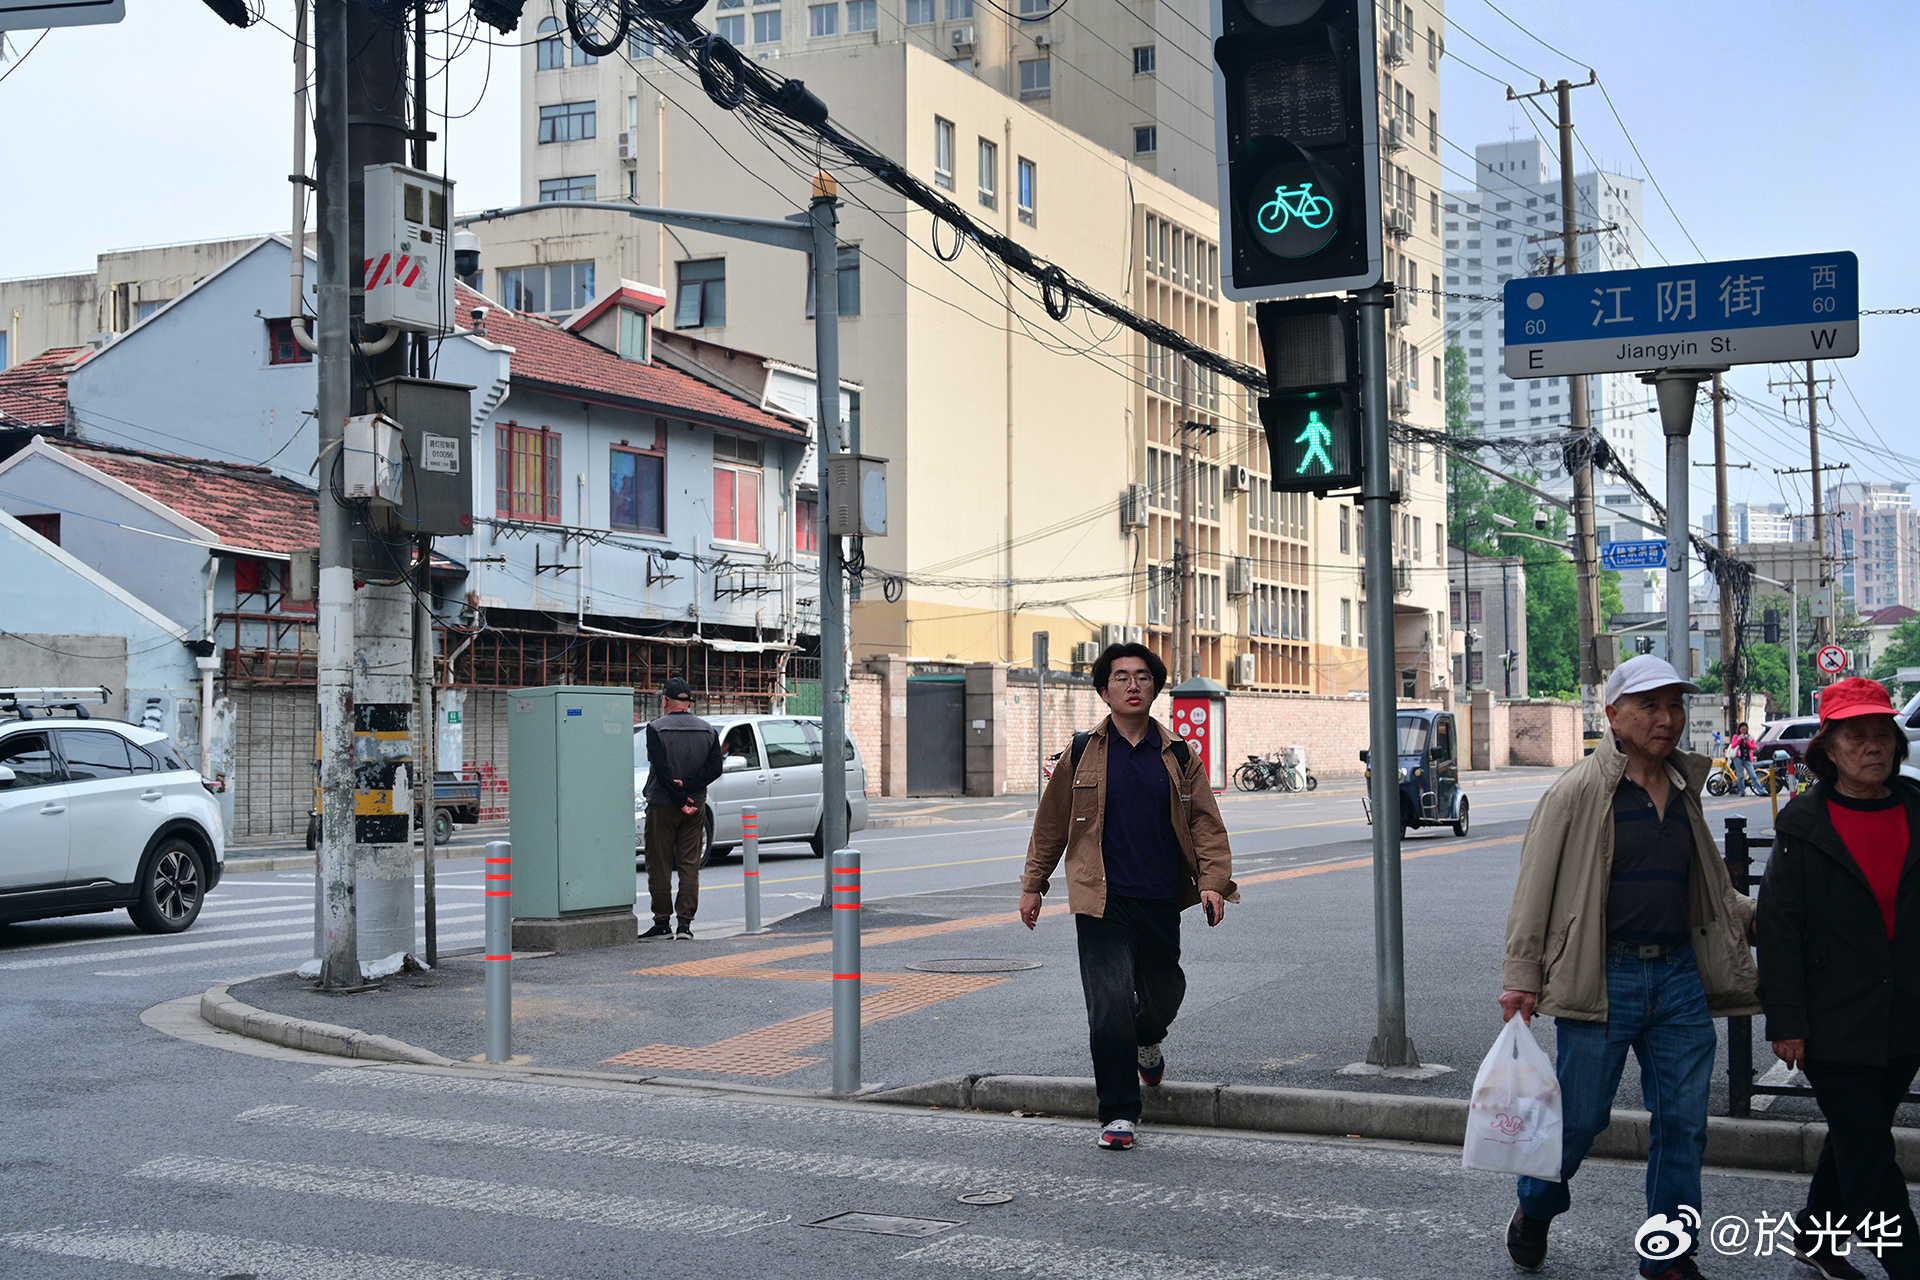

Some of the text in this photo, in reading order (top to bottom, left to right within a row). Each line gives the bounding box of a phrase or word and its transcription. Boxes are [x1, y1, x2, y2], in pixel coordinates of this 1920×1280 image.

[1810, 264, 1838, 290] 西
[1591, 274, 1766, 327] 江阴街
[1813, 296, 1836, 313] 60
[1525, 319, 1546, 335] 60
[1616, 336, 1737, 361] Jiangyin St.
[1810, 328, 1837, 350] W
[1529, 349, 1544, 369] E
